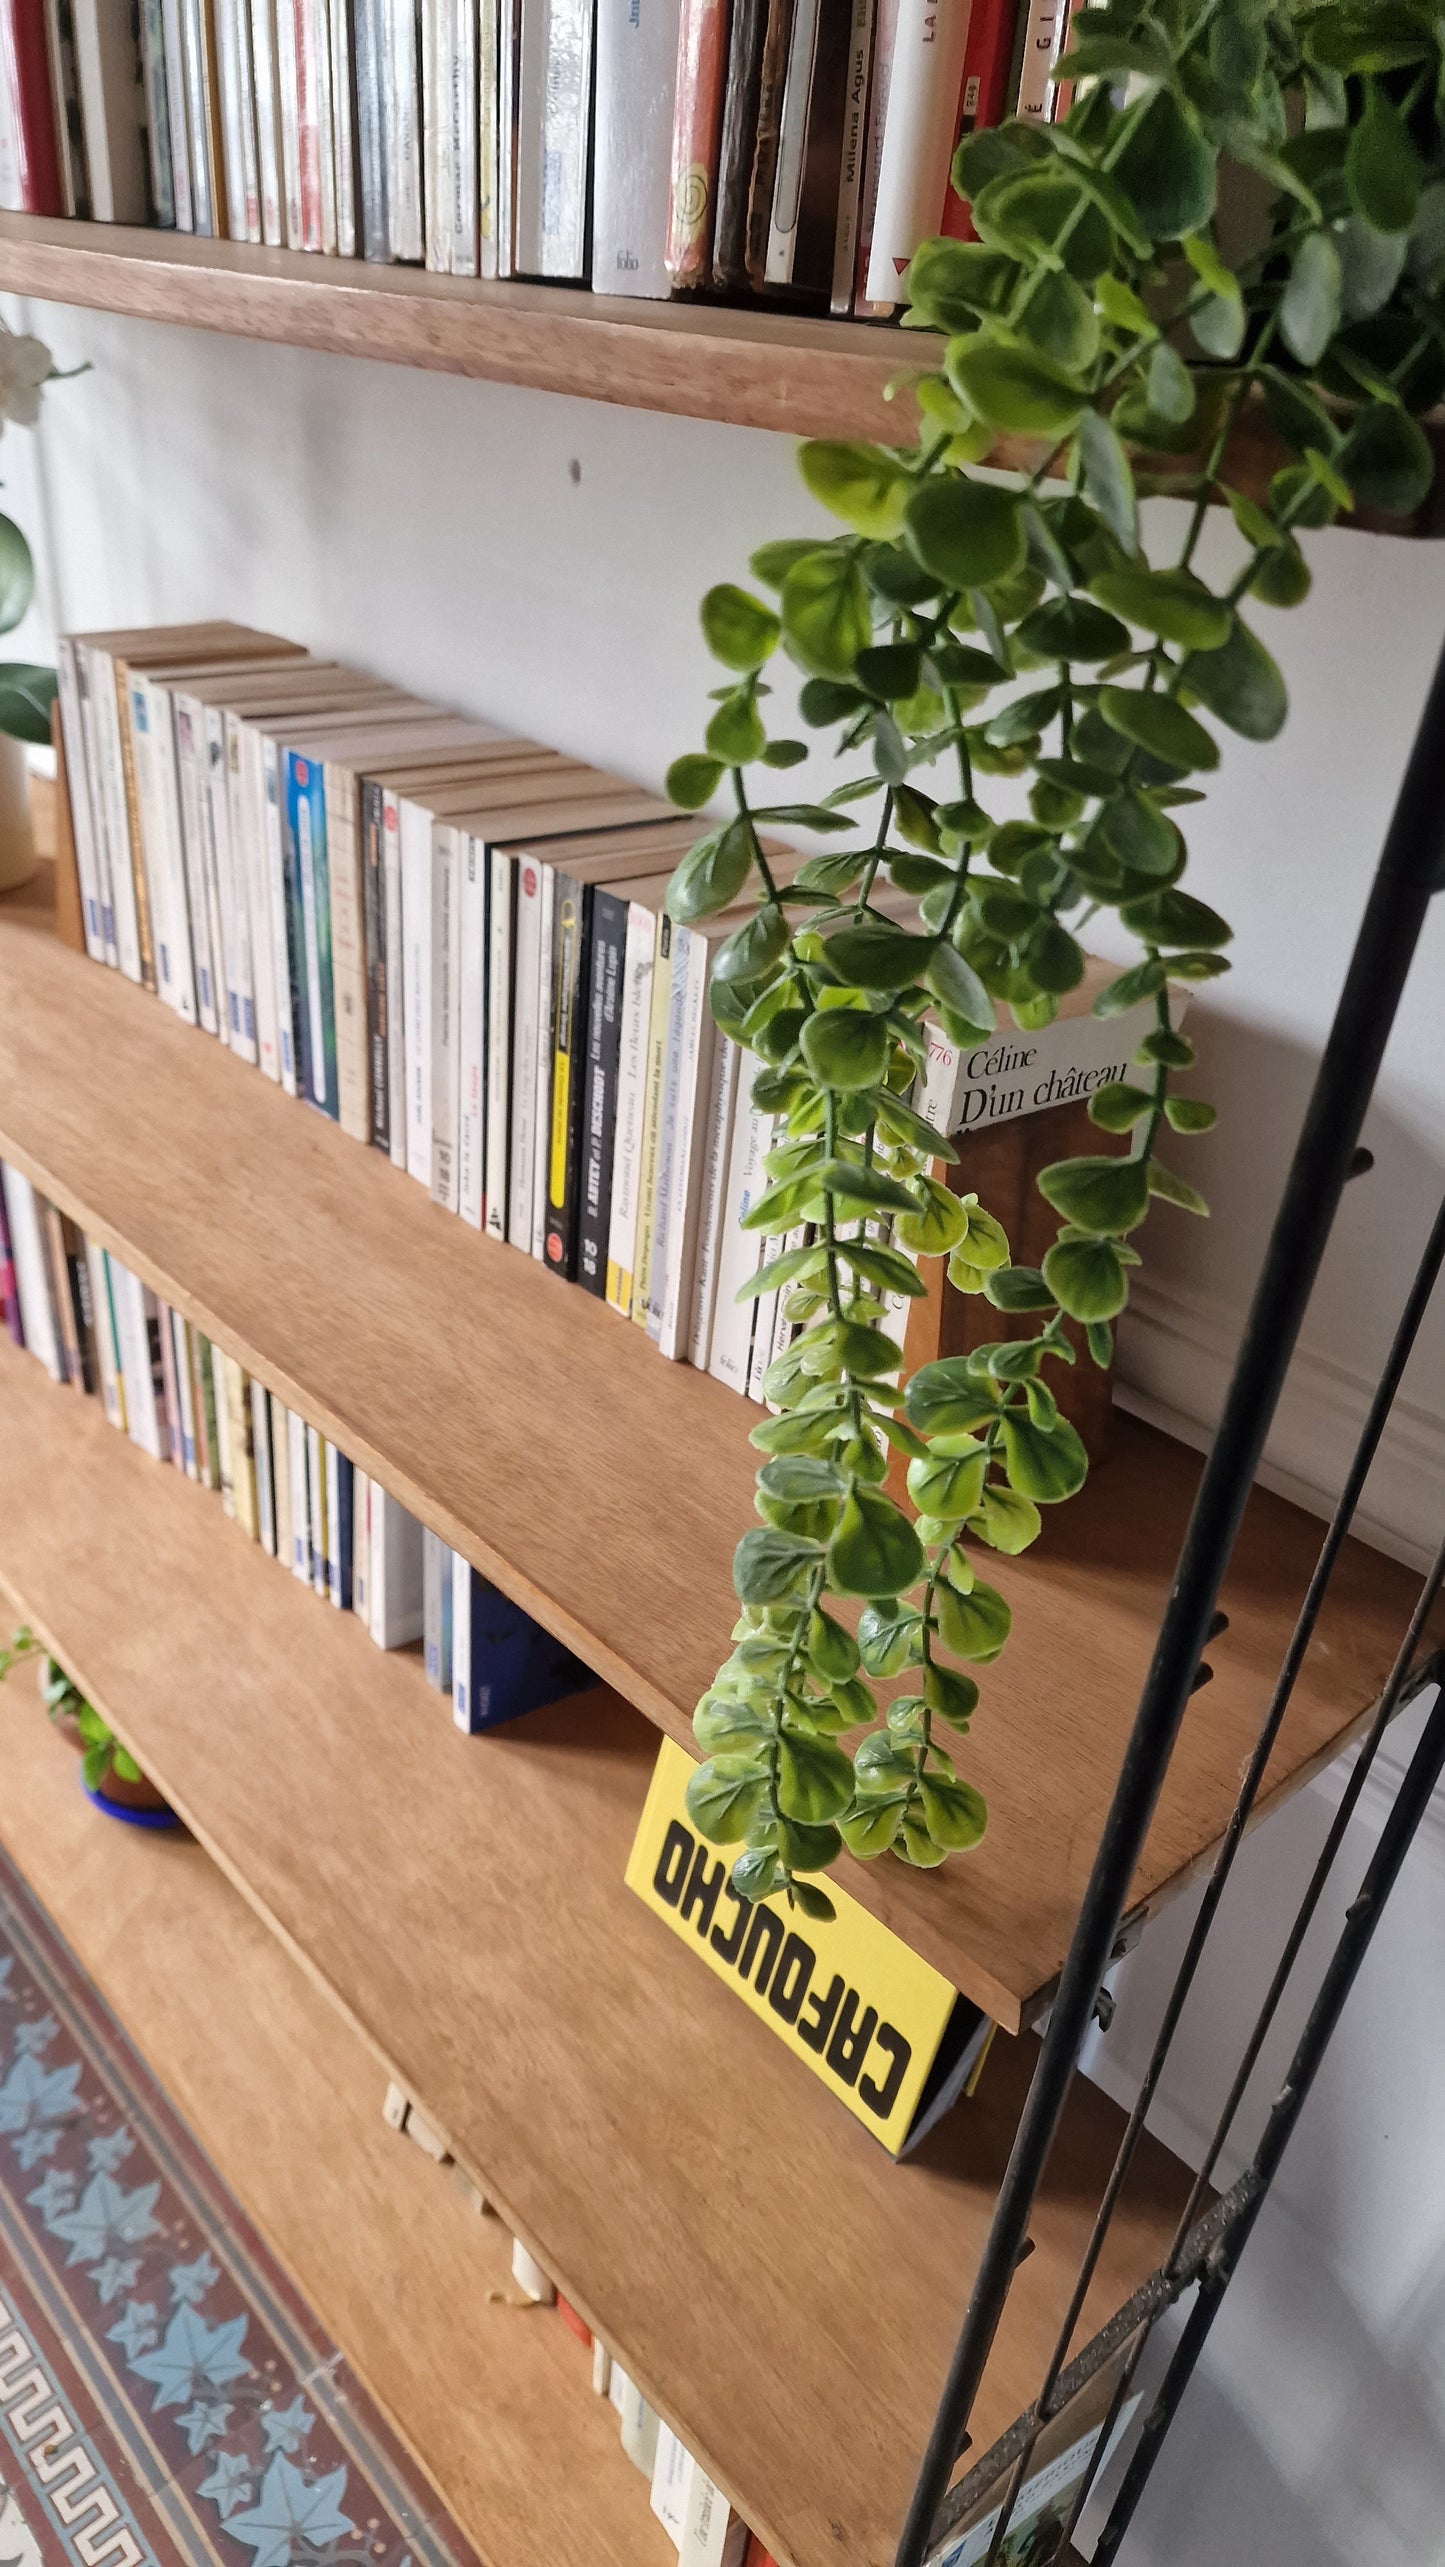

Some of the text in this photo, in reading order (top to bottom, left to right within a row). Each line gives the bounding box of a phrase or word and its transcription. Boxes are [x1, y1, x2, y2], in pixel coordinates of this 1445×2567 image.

[851, 49, 864, 104] Agus
[847, 111, 859, 182] Milena
[617, 249, 639, 270] folio
[929, 1042, 952, 1067] 776
[966, 1045, 1037, 1080] Céline
[959, 1083, 1025, 1125] D'un
[1033, 1062, 1129, 1105] château
[624, 1091, 636, 1154] Queneau
[744, 1134, 758, 1176] Voyage
[619, 1155, 632, 1220] Raymond
[699, 1259, 708, 1287] Kant
[653, 1819, 912, 2120] CAFOUCHO
